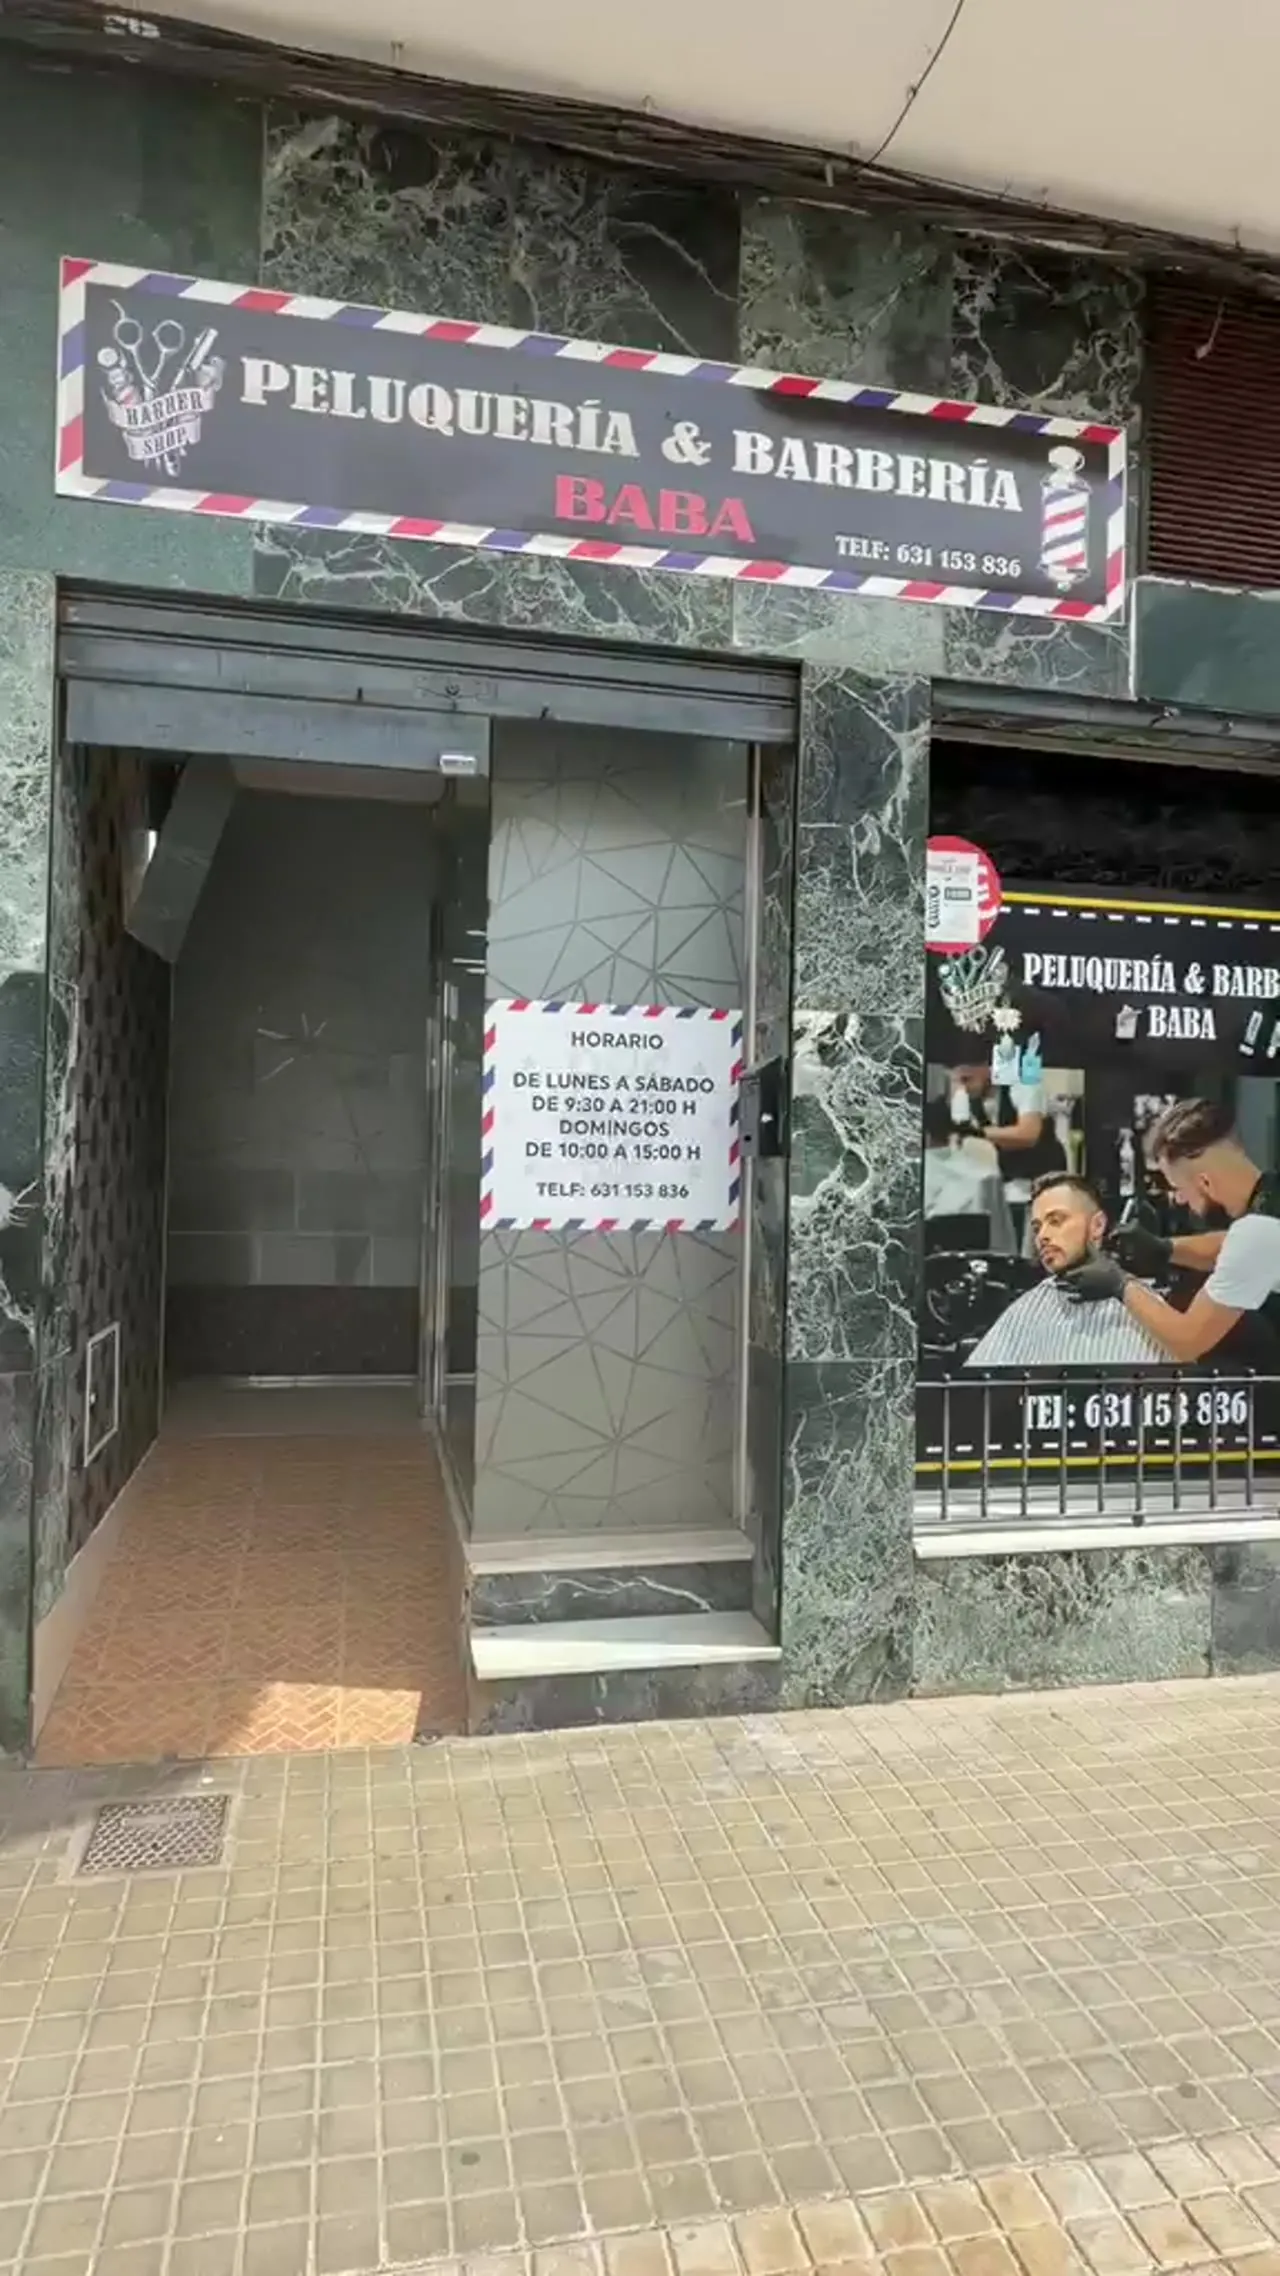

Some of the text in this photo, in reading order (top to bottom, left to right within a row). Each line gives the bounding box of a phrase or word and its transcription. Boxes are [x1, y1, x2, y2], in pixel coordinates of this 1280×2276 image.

[143, 426, 188, 455] SHOP
[240, 355, 1024, 513] PELUQUERÍA & BARBERÍA
[554, 475, 756, 544] BABA
[835, 534, 1022, 578] TELF: 631 153 836
[1022, 953, 1176, 994] PELUQUERÍA
[1184, 962, 1206, 995] &
[1147, 1005, 1217, 1040] BABA
[570, 1031, 664, 1050] HORARIO
[513, 1071, 715, 1094] DE LUNES A SÁBADO
[532, 1095, 697, 1115] DE 9:30 A 21:00 H
[559, 1119, 670, 1137] DOMINGOS
[525, 1142, 701, 1160] DE 10:00 A 15:00 H
[536, 1182, 690, 1199] TELF: 631 153 836
[1084, 1392, 1132, 1429] 631
[1196, 1390, 1248, 1426] 836
